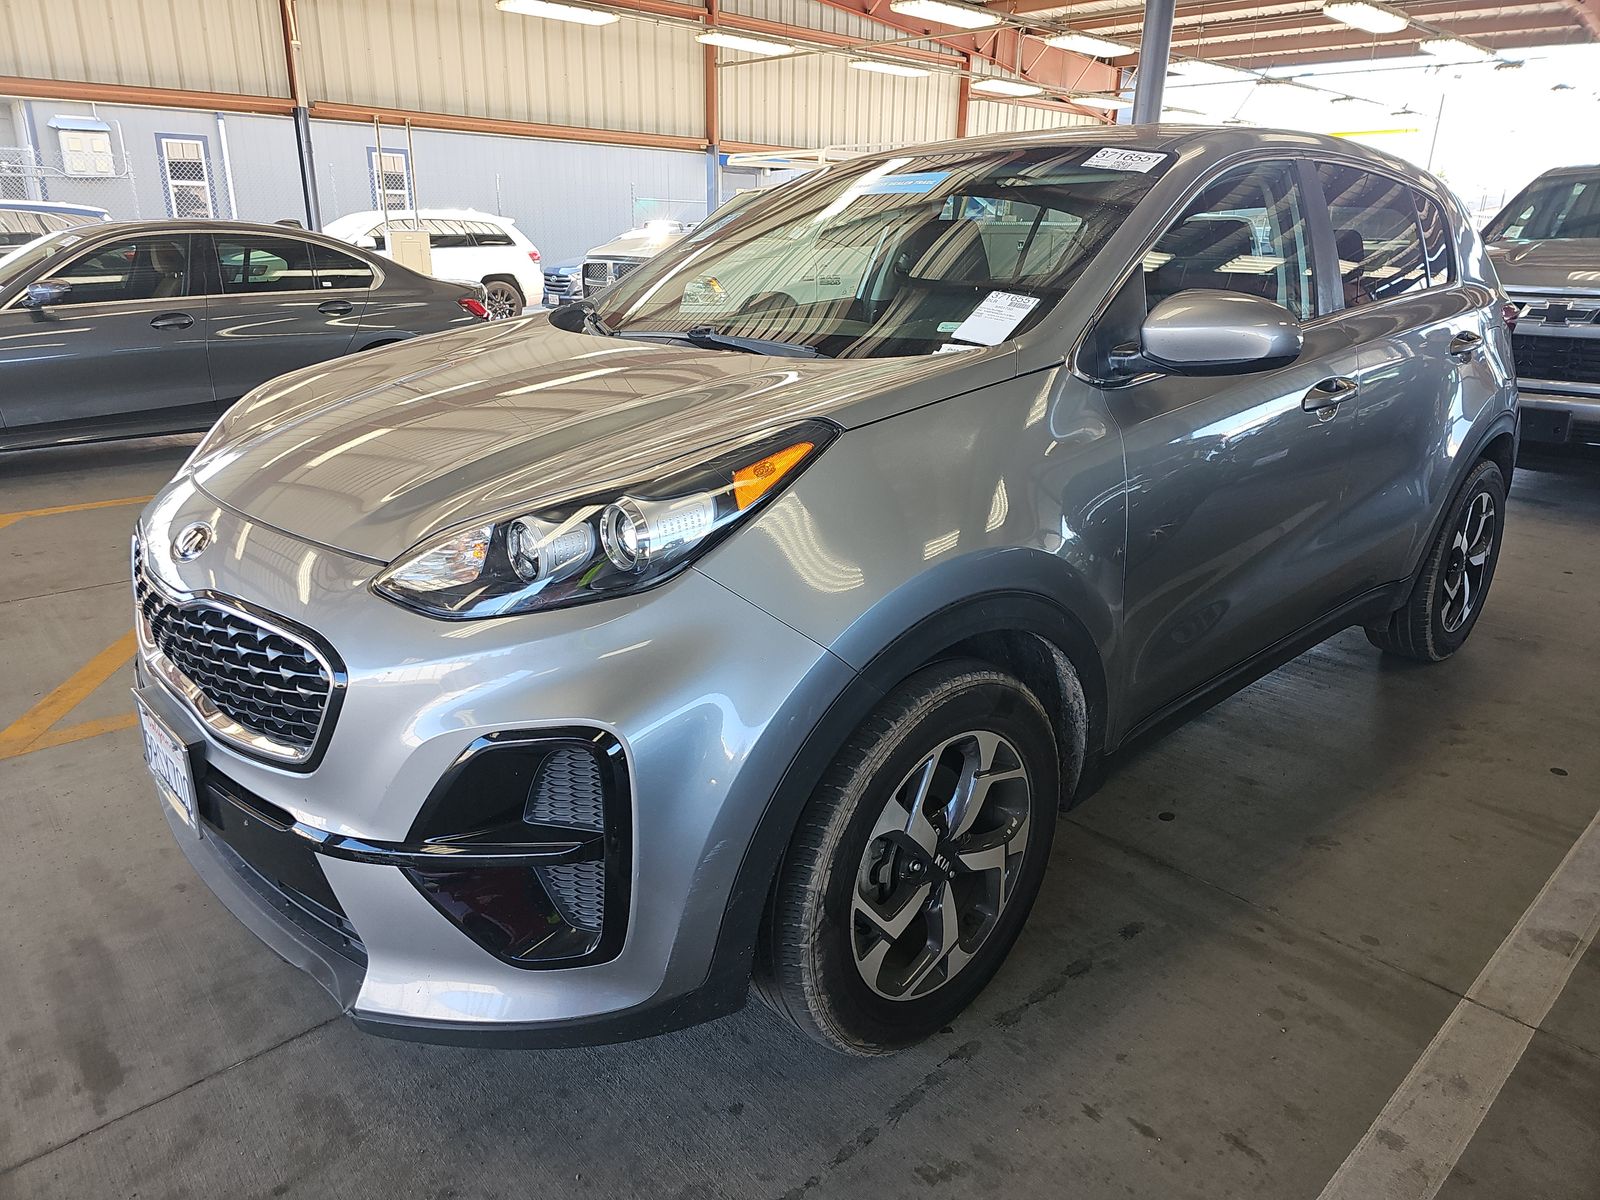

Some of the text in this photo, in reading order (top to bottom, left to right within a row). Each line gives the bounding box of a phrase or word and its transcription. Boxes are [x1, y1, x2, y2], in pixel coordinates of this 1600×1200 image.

[1095, 150, 1161, 163] 3716551
[991, 292, 1037, 305] 3716551
[934, 853, 950, 872] KIA
